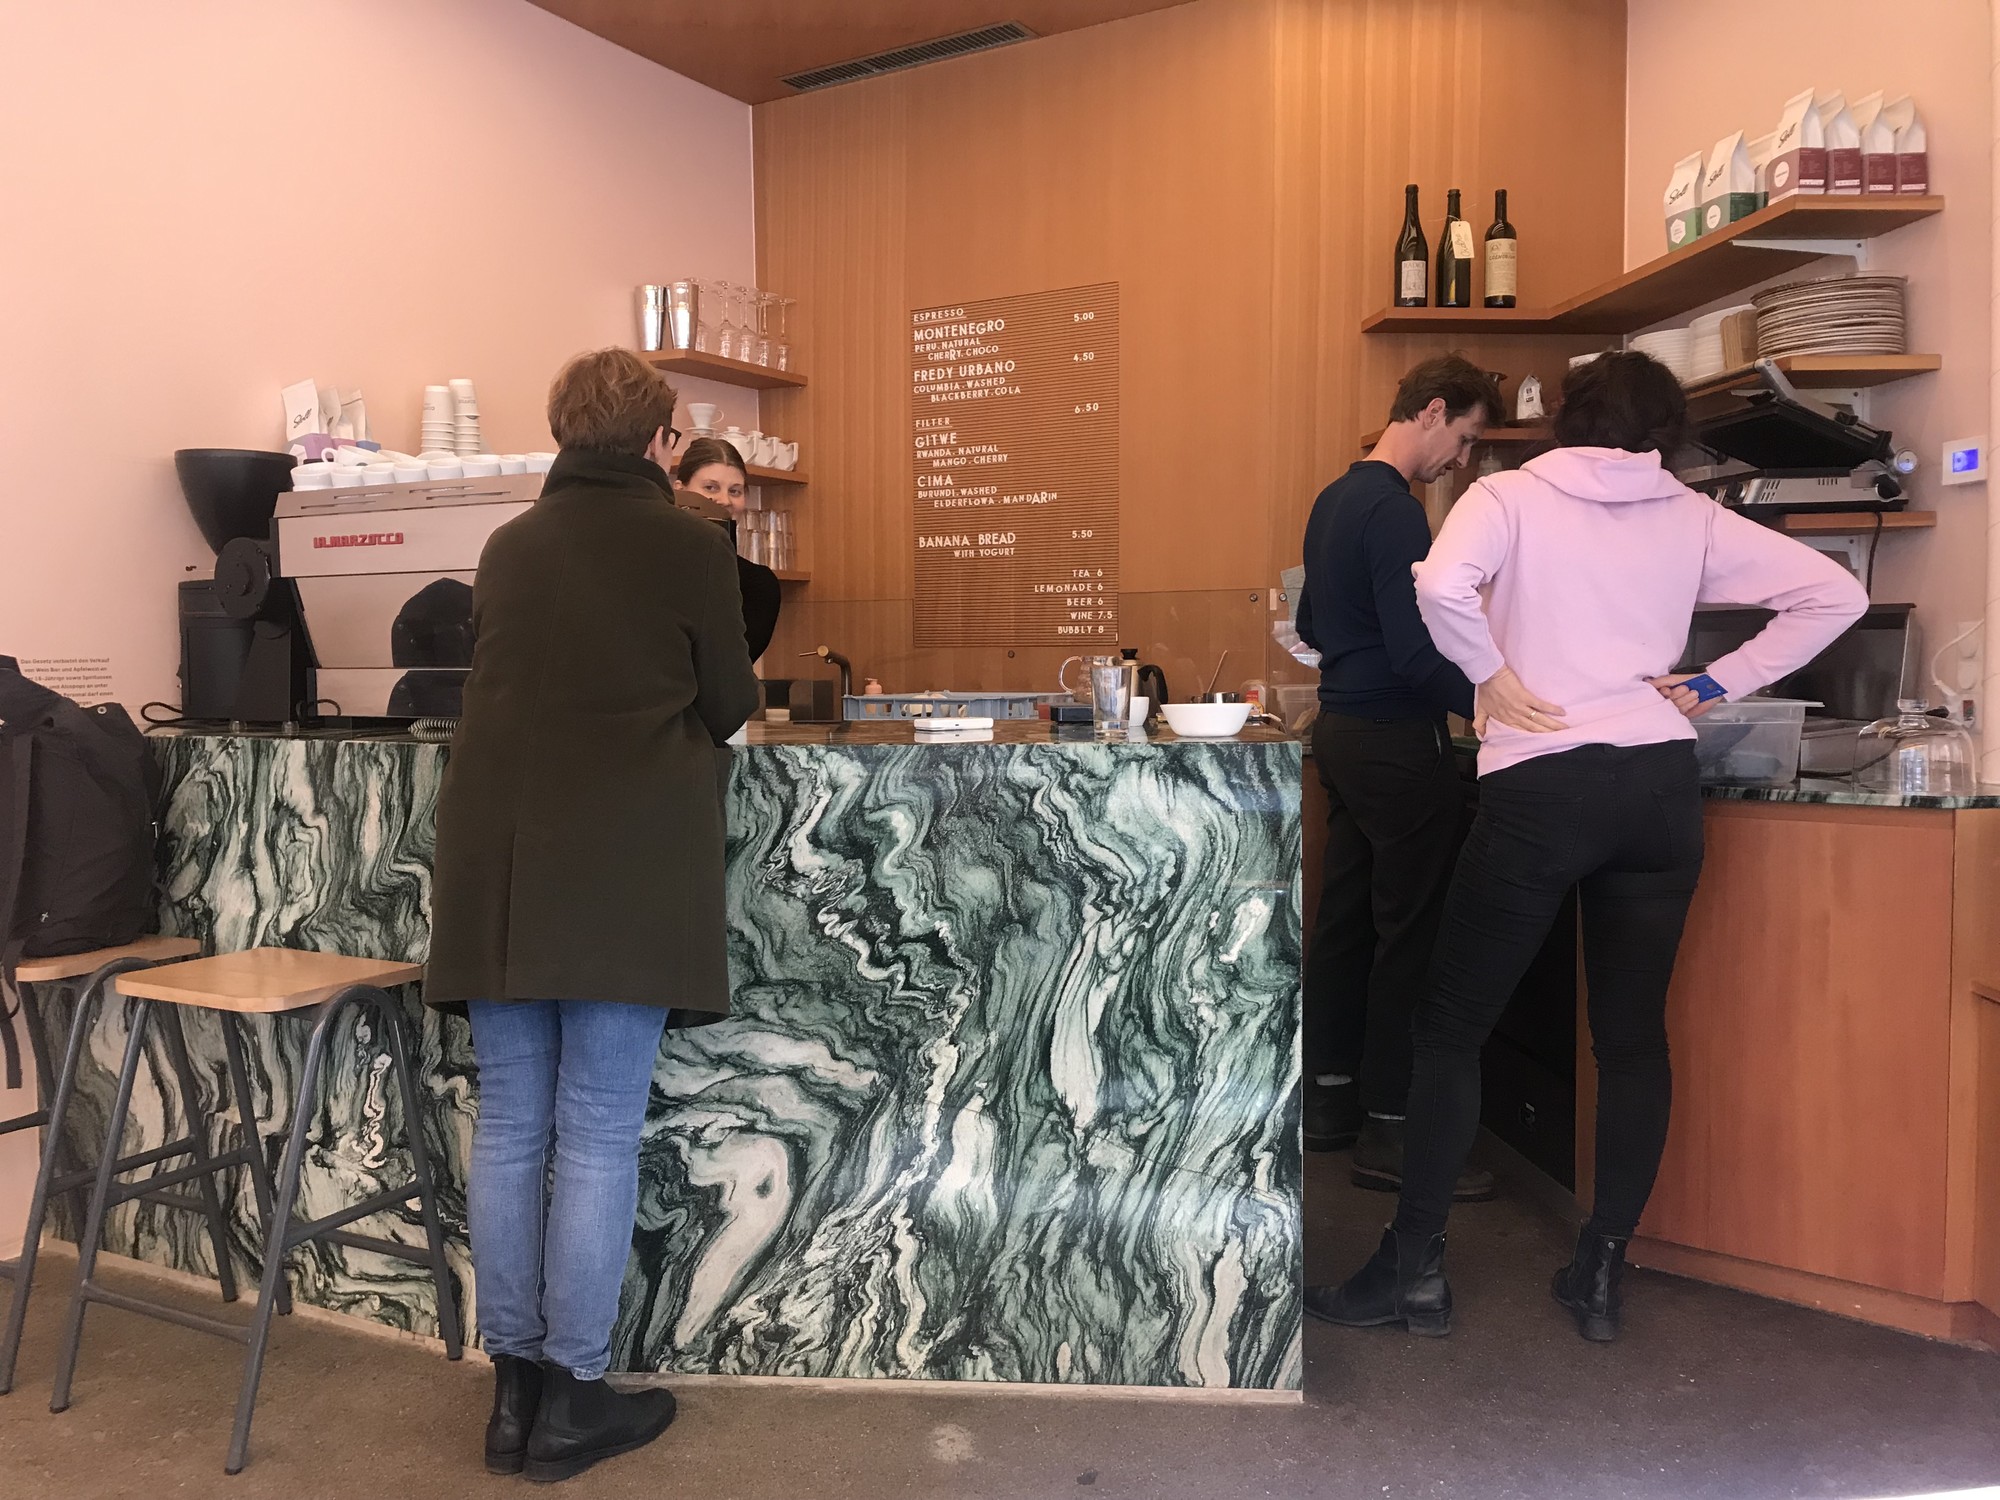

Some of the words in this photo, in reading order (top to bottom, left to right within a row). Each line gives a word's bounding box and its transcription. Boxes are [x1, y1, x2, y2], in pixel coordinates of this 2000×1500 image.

[913, 308, 964, 322] ESPRESSO
[1073, 311, 1095, 322] 5.00
[914, 318, 1005, 342] MONTENEGRO
[966, 345, 999, 357] CHOCO
[1073, 352, 1095, 362] 4.50
[914, 366, 953, 382] FREDY
[959, 360, 1015, 378] URBANO
[966, 376, 1006, 388] WASHED
[994, 386, 1021, 396] COLA
[1074, 403, 1099, 414] 6.50
[916, 417, 950, 428] FILTER
[915, 432, 957, 448] GITWE
[958, 444, 999, 456] NATURAL
[973, 453, 1008, 465] CHERRY
[917, 474, 954, 487] CIMA
[960, 486, 998, 496] WASHED
[1003, 491, 1058, 505] MANDARIN
[1071, 529, 1093, 539] 5.50
[918, 534, 970, 548] BANANA
[978, 532, 1016, 546] BREAD
[953, 549, 975, 558] WITH
[979, 547, 1015, 557] YOGURT
[1072, 569, 1090, 578] TEA
[1096, 568, 1103, 577] 6
[1034, 583, 1092, 593] LEMONADE
[1097, 582, 1104, 591] 6
[1066, 597, 1092, 607] BEER
[1097, 597, 1104, 606] 6
[1070, 611, 1093, 620] WINE
[1098, 610, 1113, 620] 7.5
[1057, 625, 1092, 635] BUBBLY
[1098, 625, 1104, 634] 8
